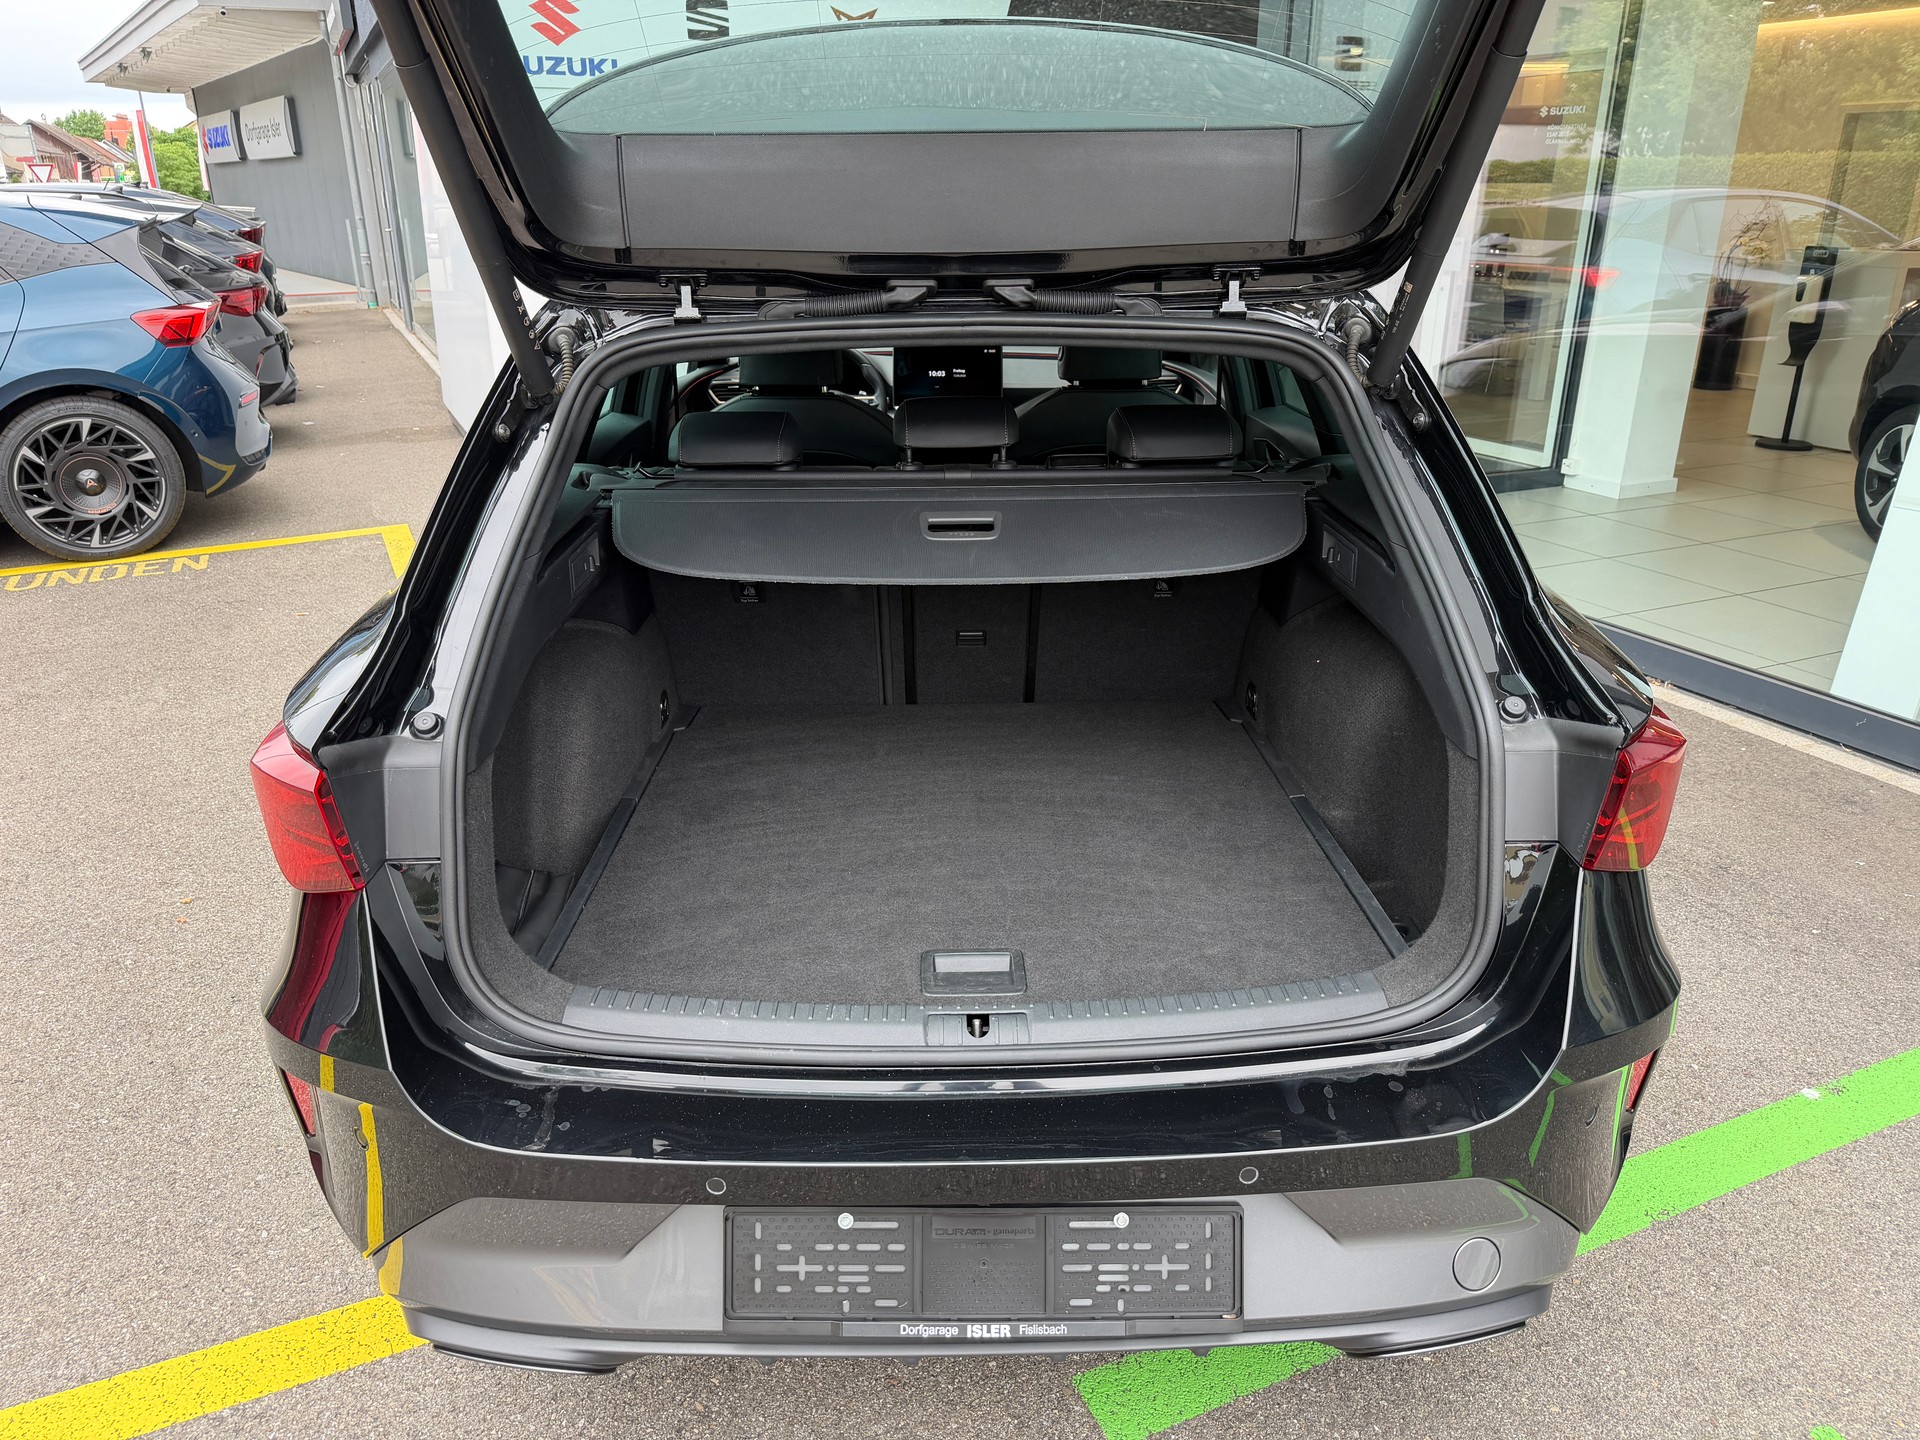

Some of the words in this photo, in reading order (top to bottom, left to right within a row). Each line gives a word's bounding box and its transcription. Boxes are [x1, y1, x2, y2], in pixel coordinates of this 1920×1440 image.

[522, 55, 618, 76] UZUKI
[1550, 105, 1586, 115] SUZUKI
[207, 124, 231, 149] SUZUKI
[245, 121, 271, 145] Dorfgarage
[928, 370, 946, 378] 10:03
[0, 555, 210, 592] UNDEN
[993, 1227, 1035, 1236] gamaparts
[900, 1324, 959, 1337] Dorfgarage
[966, 1324, 1011, 1338] ISLER
[1019, 1323, 1068, 1335] Fislisbach
